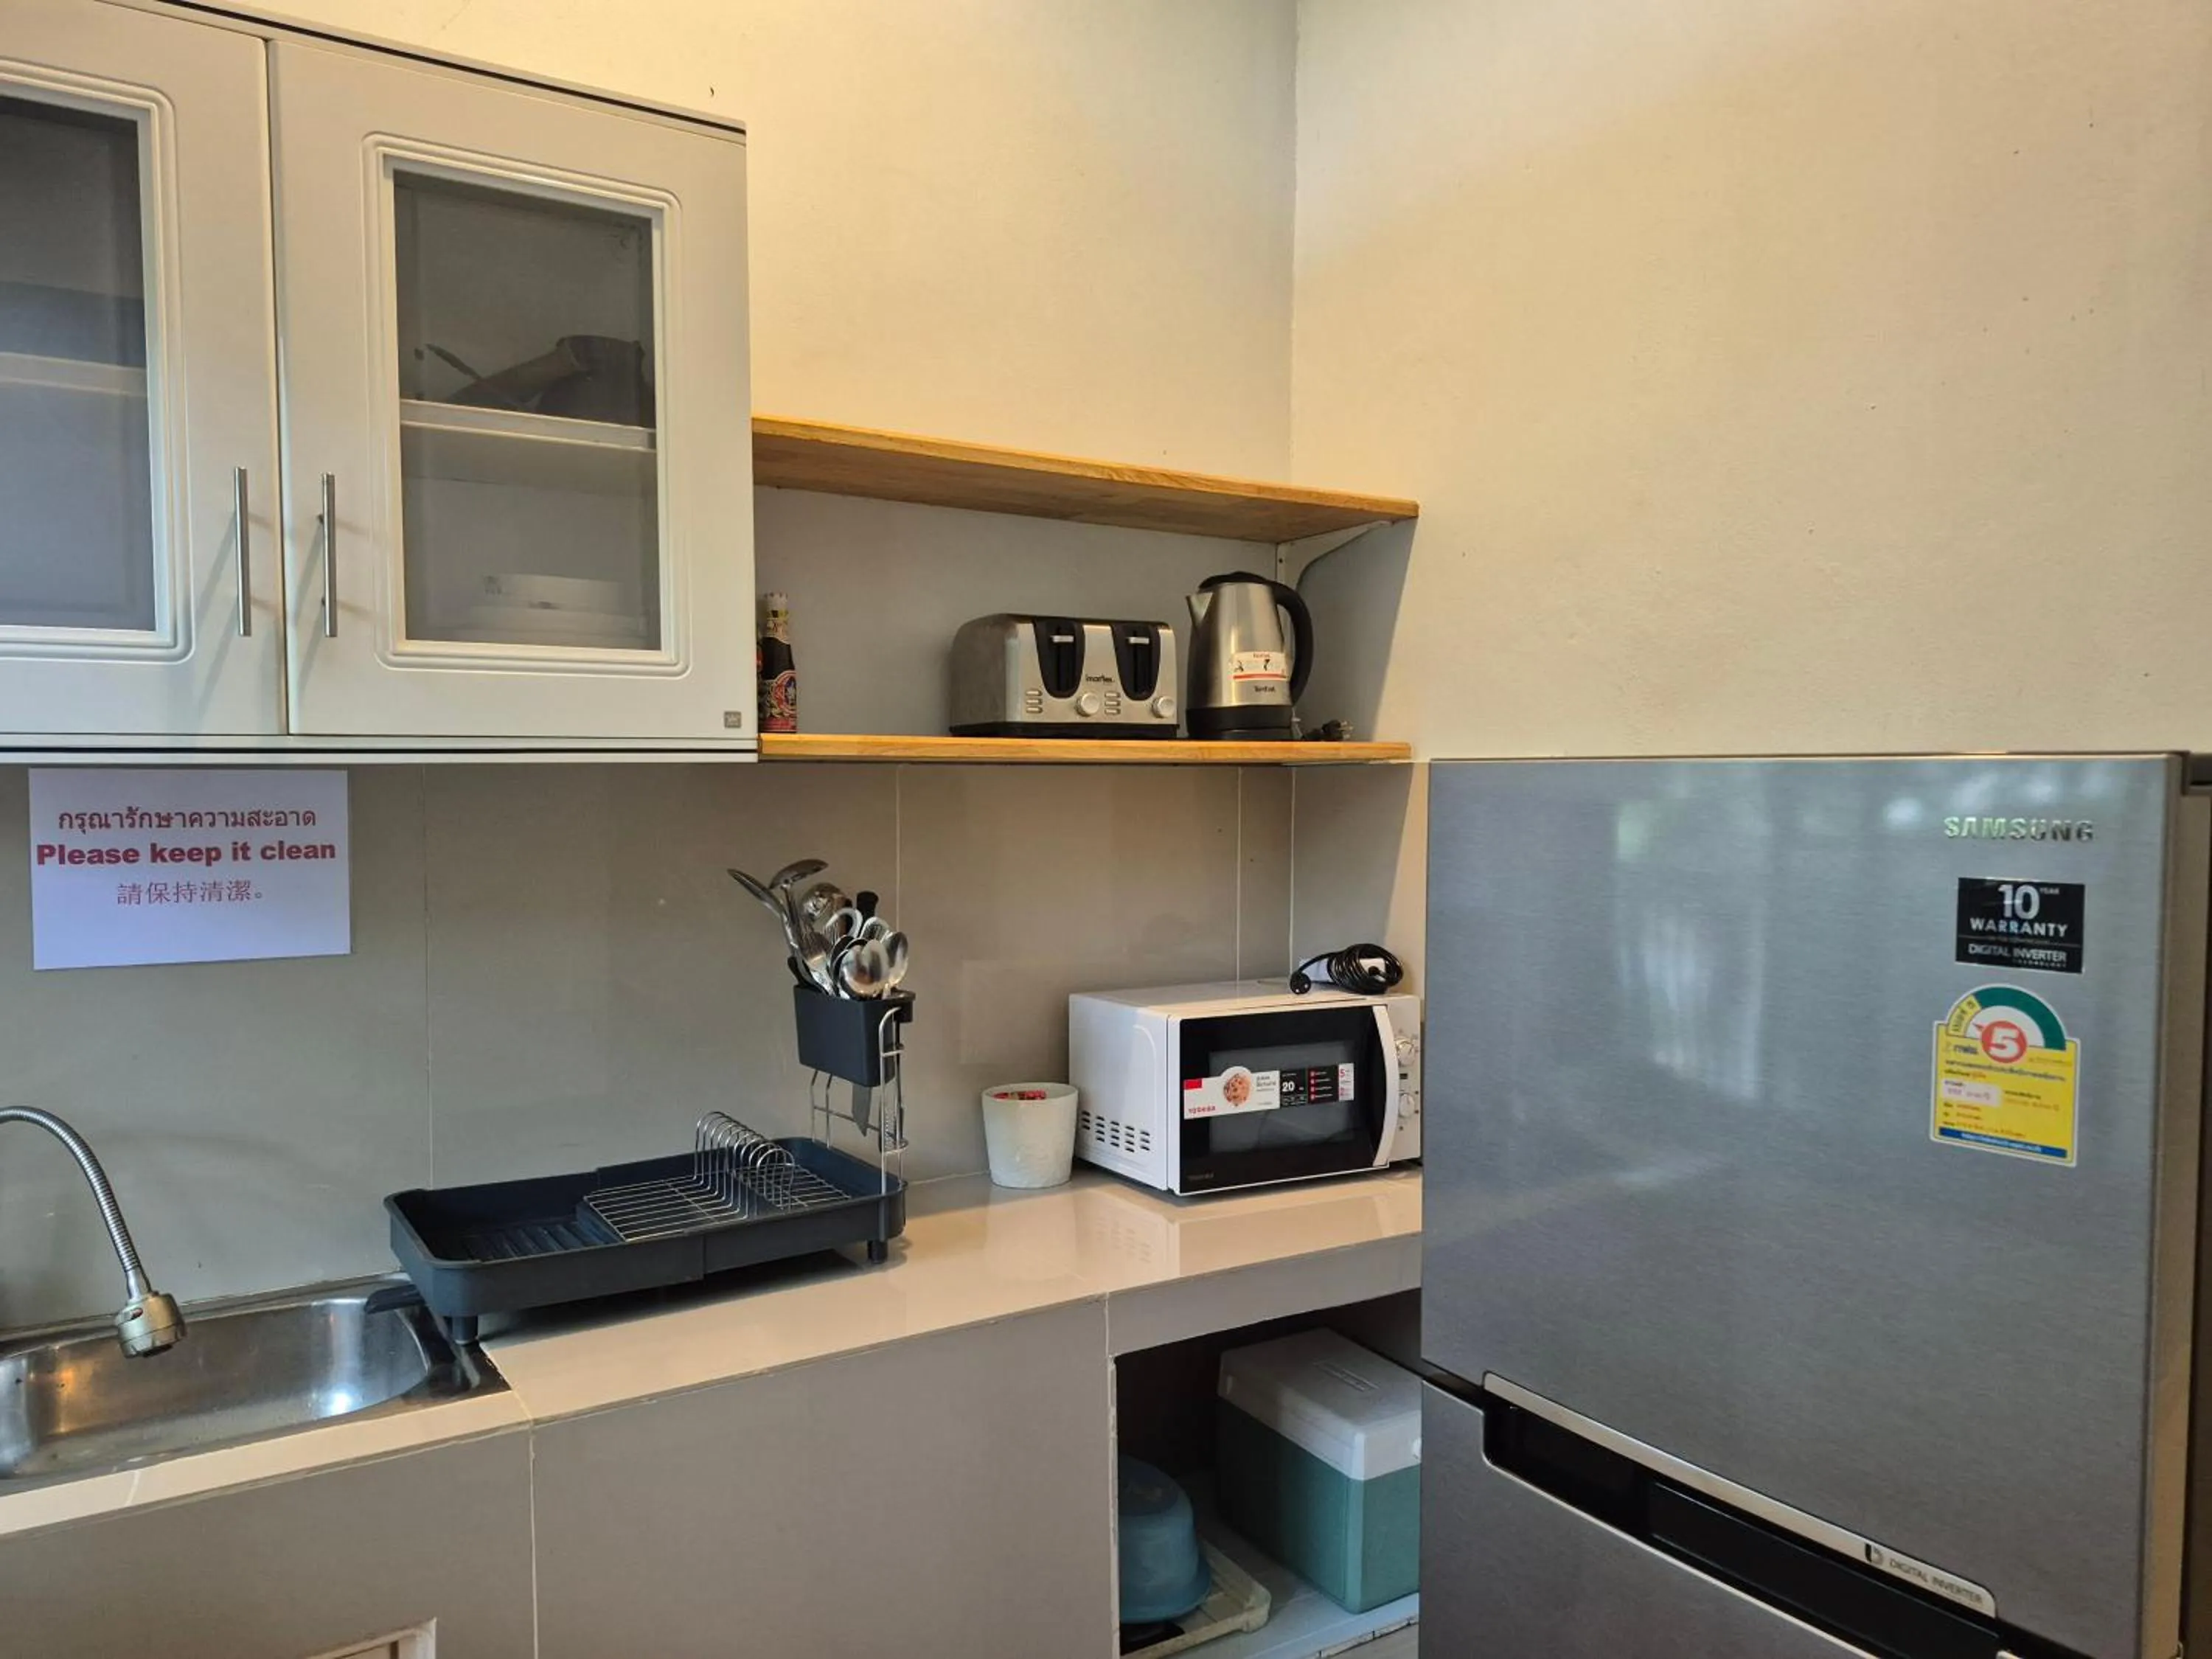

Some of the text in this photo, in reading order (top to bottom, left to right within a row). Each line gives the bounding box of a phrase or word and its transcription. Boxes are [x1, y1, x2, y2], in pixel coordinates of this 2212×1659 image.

[58, 806, 316, 835] กรุณารักษาความสะอาด
[1944, 816, 2094, 842] SAMSUNG
[36, 841, 335, 867] Please keep it clean
[1998, 884, 2040, 919] 10
[1969, 917, 2068, 937] WARRANTY
[1968, 943, 2067, 961] DIGITAL INVERTER
[1988, 1027, 2020, 1060] 5
[1282, 1080, 1295, 1091] 20
